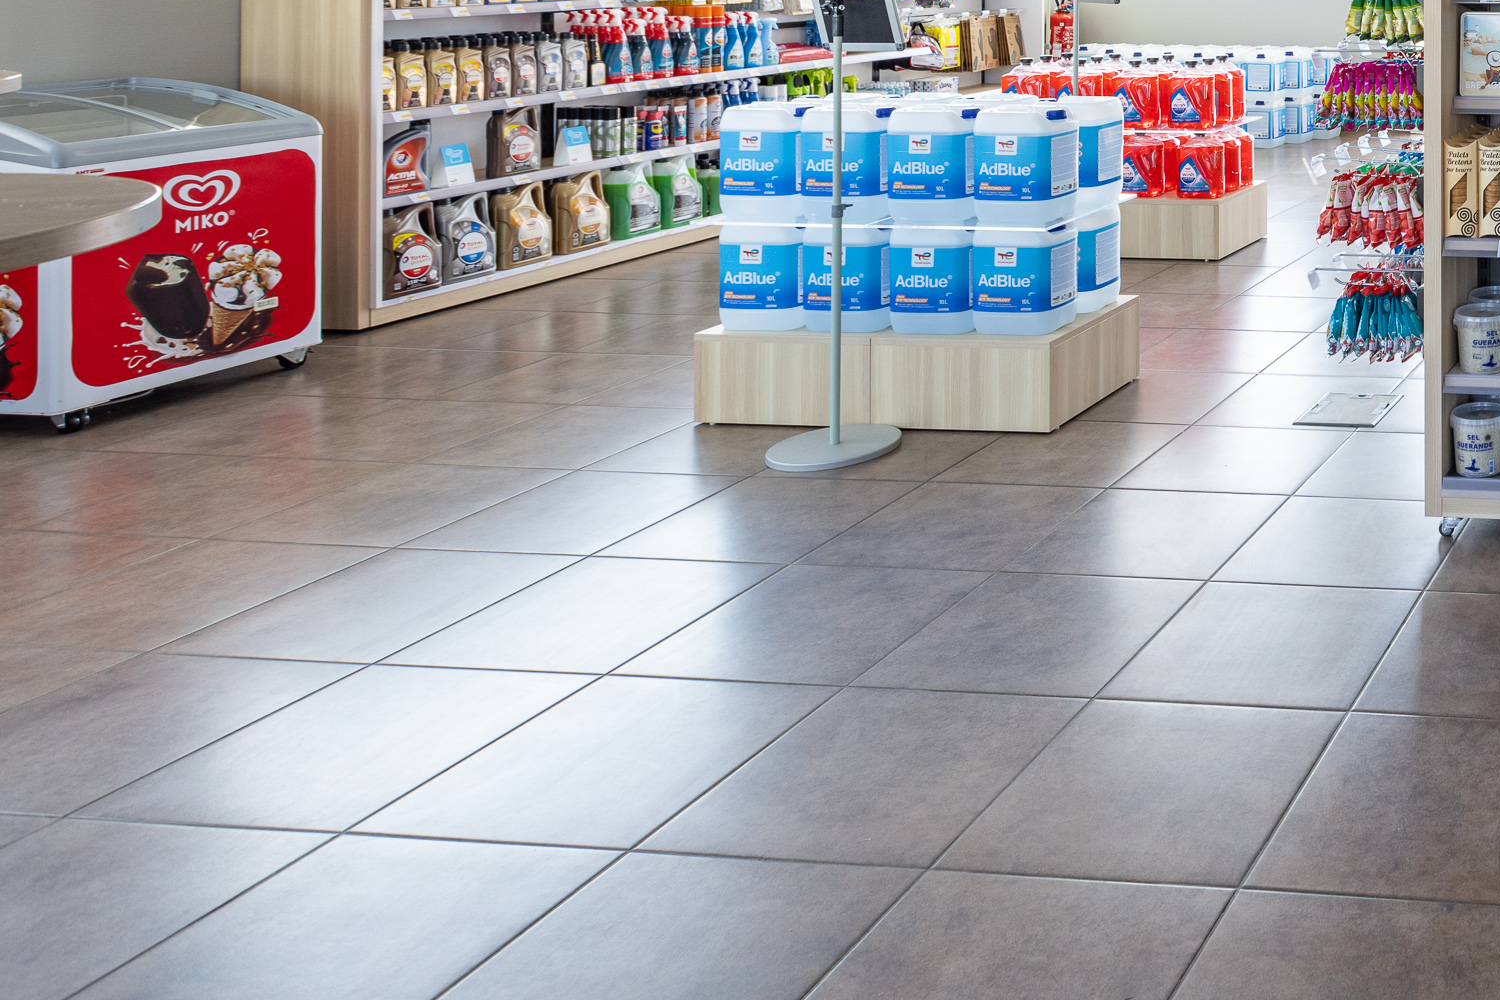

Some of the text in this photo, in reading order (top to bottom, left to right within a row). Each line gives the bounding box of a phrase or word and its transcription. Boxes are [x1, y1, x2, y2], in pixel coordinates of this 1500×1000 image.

[723, 158, 775, 172] AdBlue
[806, 159, 859, 172] AdBue
[893, 161, 945, 175] AdBlue
[1447, 158, 1472, 166] Bretons
[387, 170, 416, 181] ACTIVA
[979, 162, 1031, 176] AdBlue
[175, 211, 229, 234] MIKO
[410, 253, 429, 261] TOTAL
[723, 271, 776, 284] AdBlue
[807, 273, 859, 286] AdBue
[895, 275, 948, 288] AdBlue
[978, 274, 1031, 288] AdBlue
[1457, 441, 1493, 450] GUERANDE
